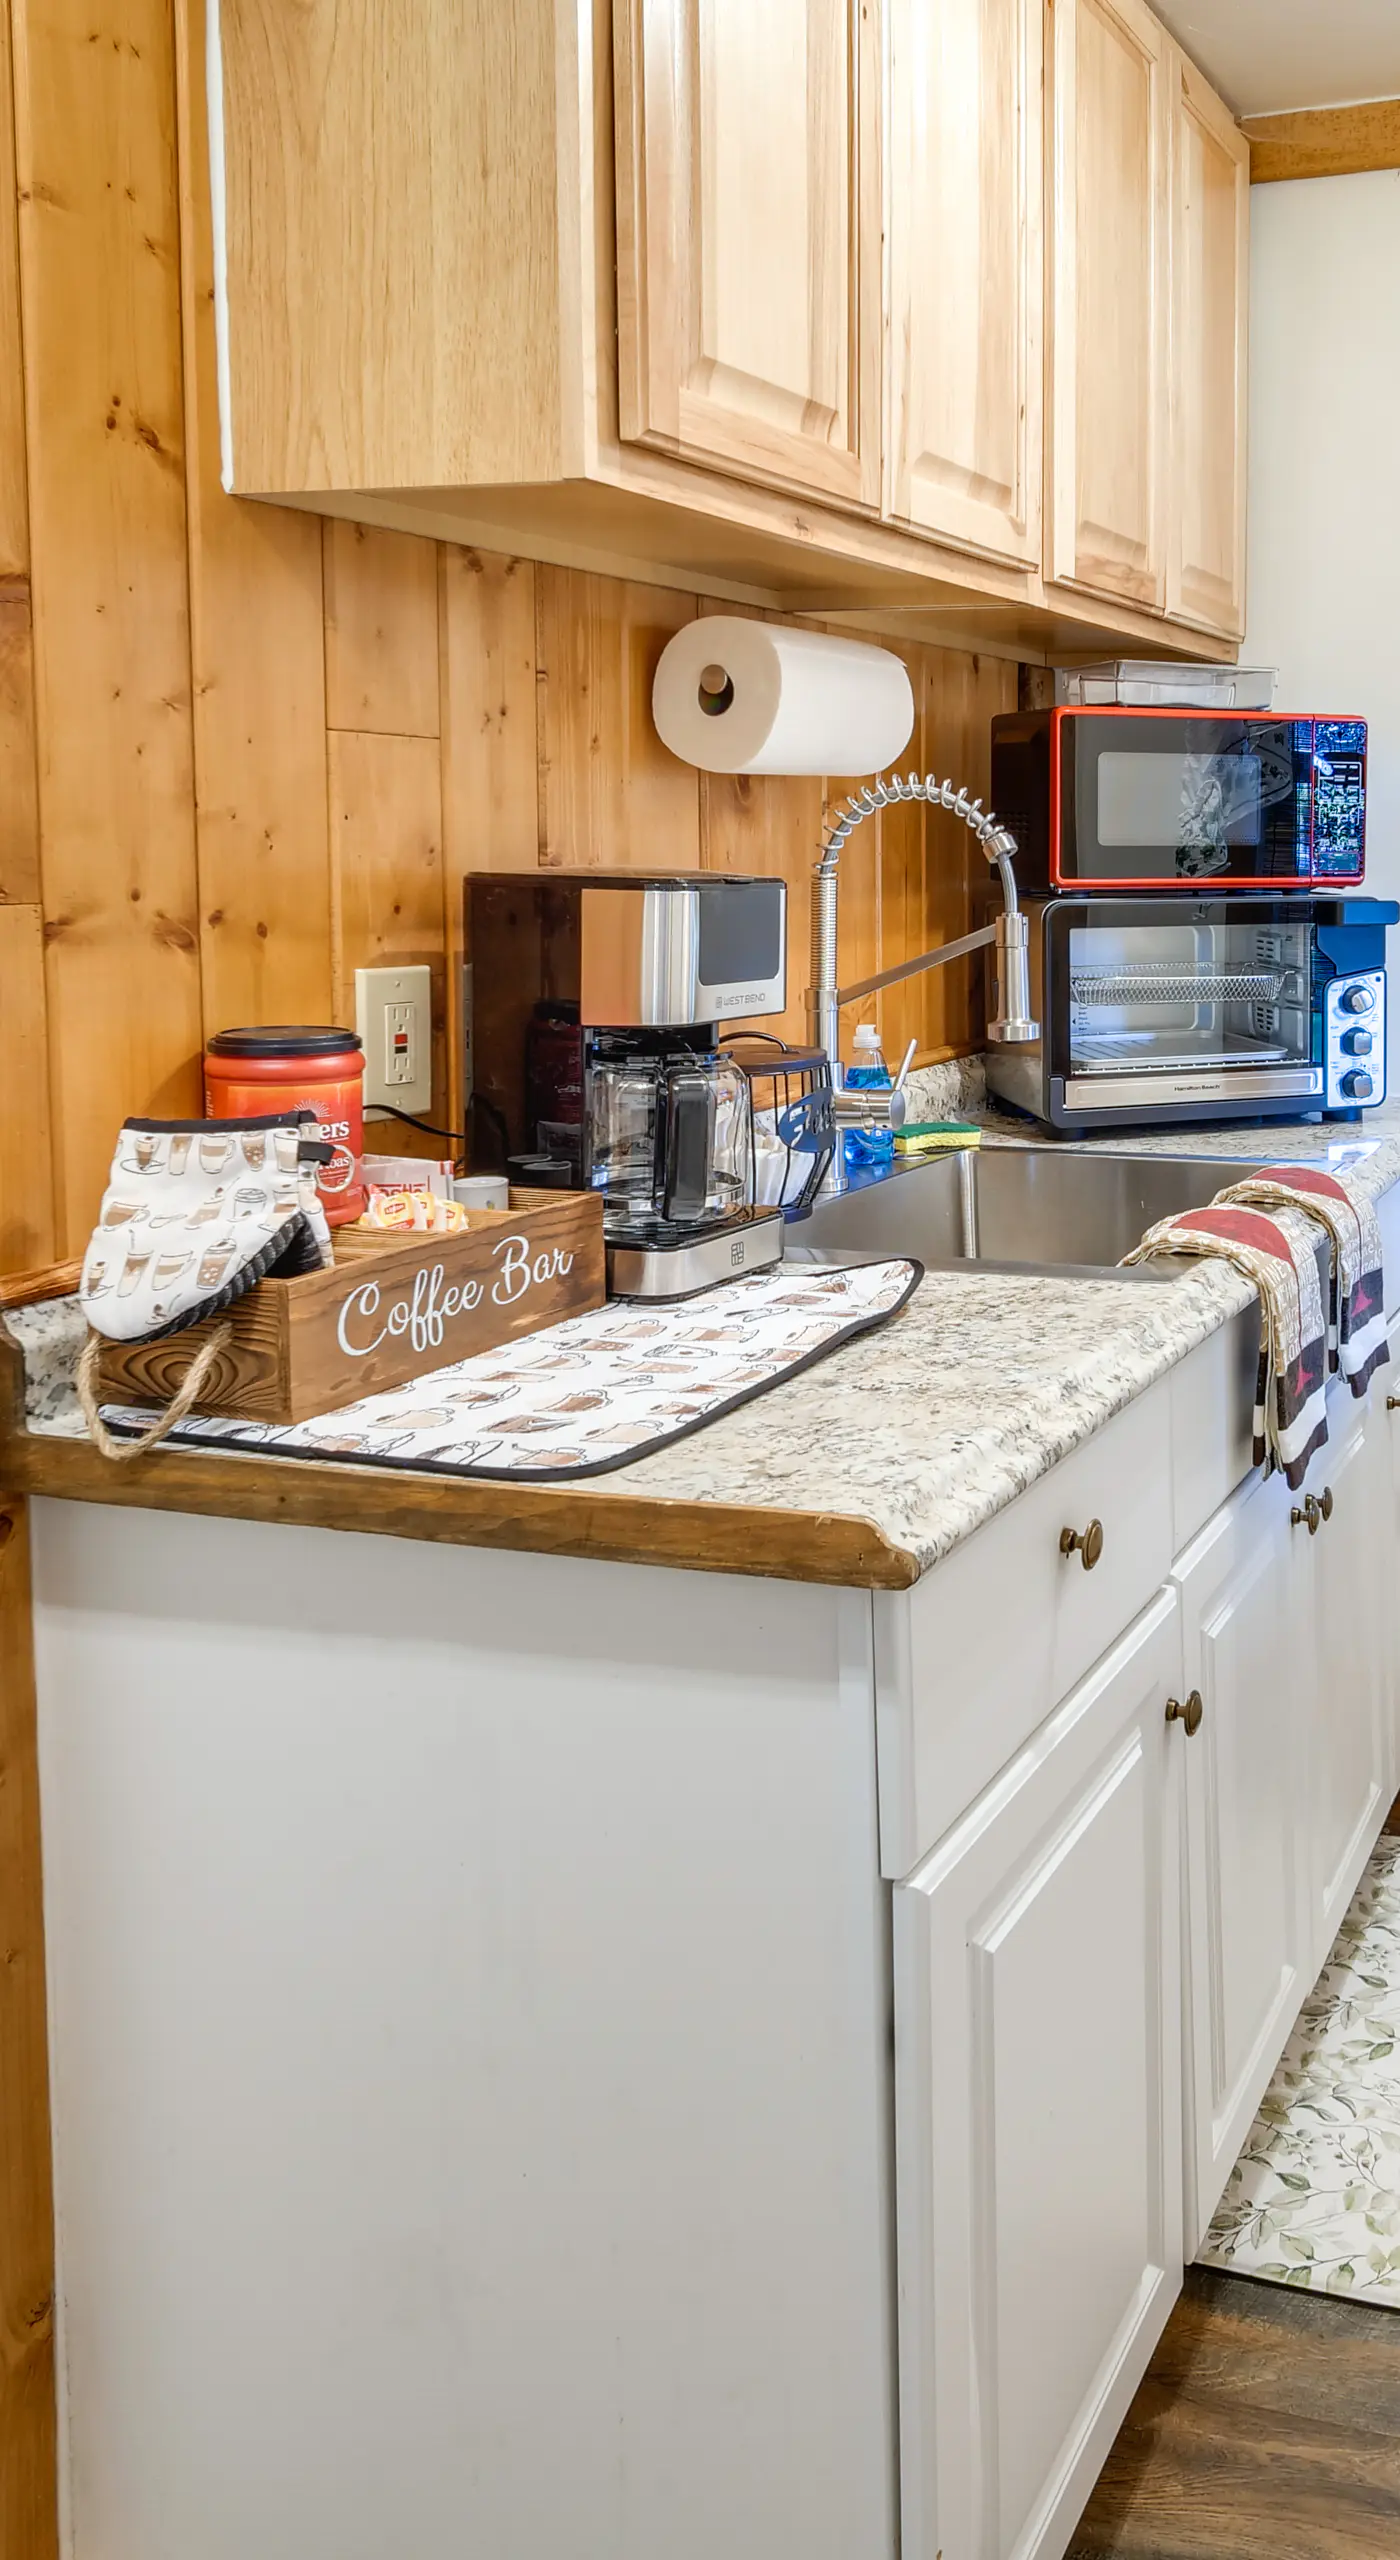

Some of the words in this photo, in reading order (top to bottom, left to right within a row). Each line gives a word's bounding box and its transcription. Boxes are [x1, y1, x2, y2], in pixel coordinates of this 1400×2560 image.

[723, 995, 744, 1006] WEST
[319, 1120, 350, 1140] ers
[337, 1264, 484, 1357] Coffee
[492, 1235, 574, 1305] Bar
